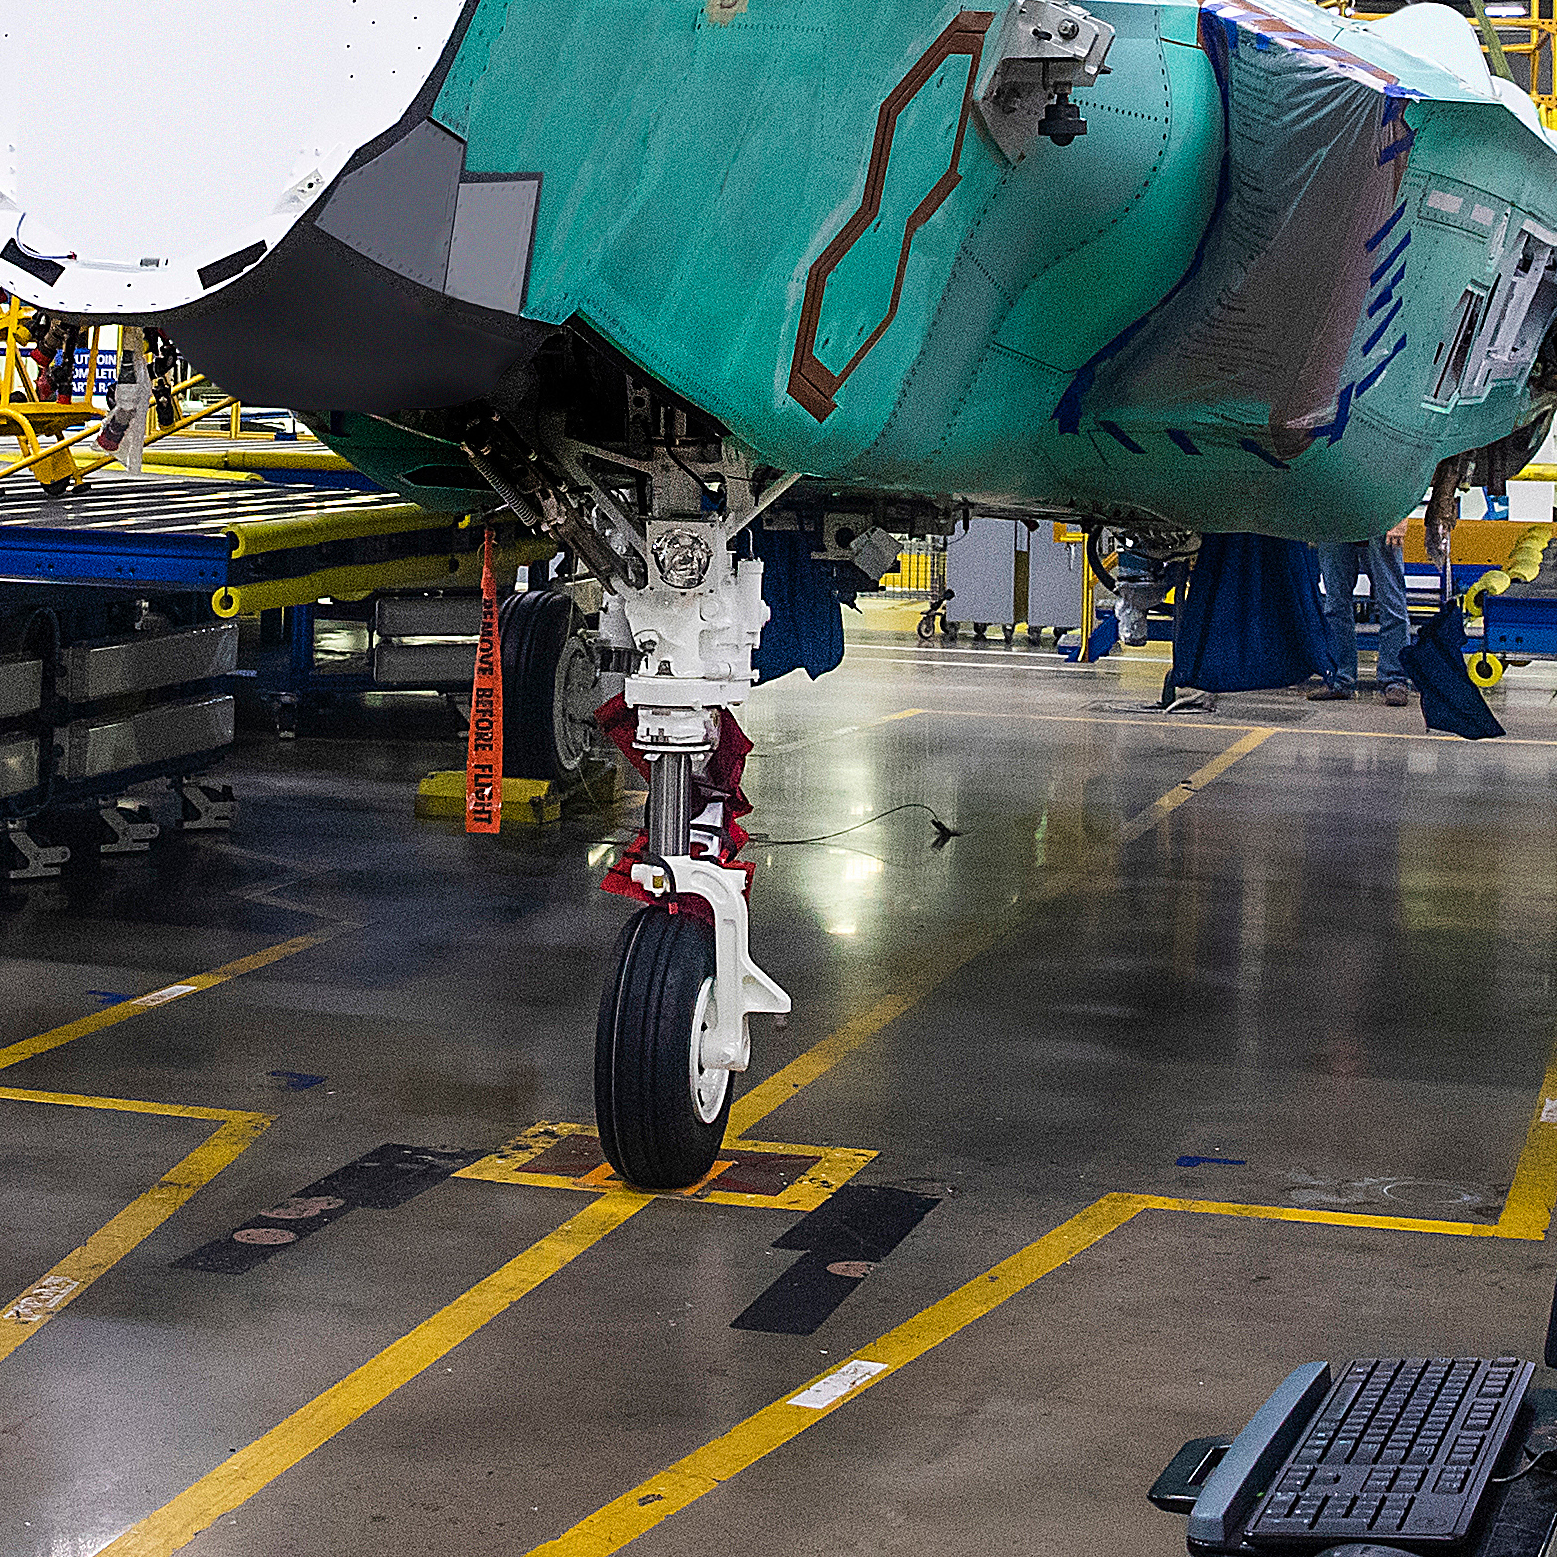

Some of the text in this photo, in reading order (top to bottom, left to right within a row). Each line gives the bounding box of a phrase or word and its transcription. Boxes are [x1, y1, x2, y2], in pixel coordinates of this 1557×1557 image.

[472, 598, 494, 825] REMOVE BEFORE FLIGHT
